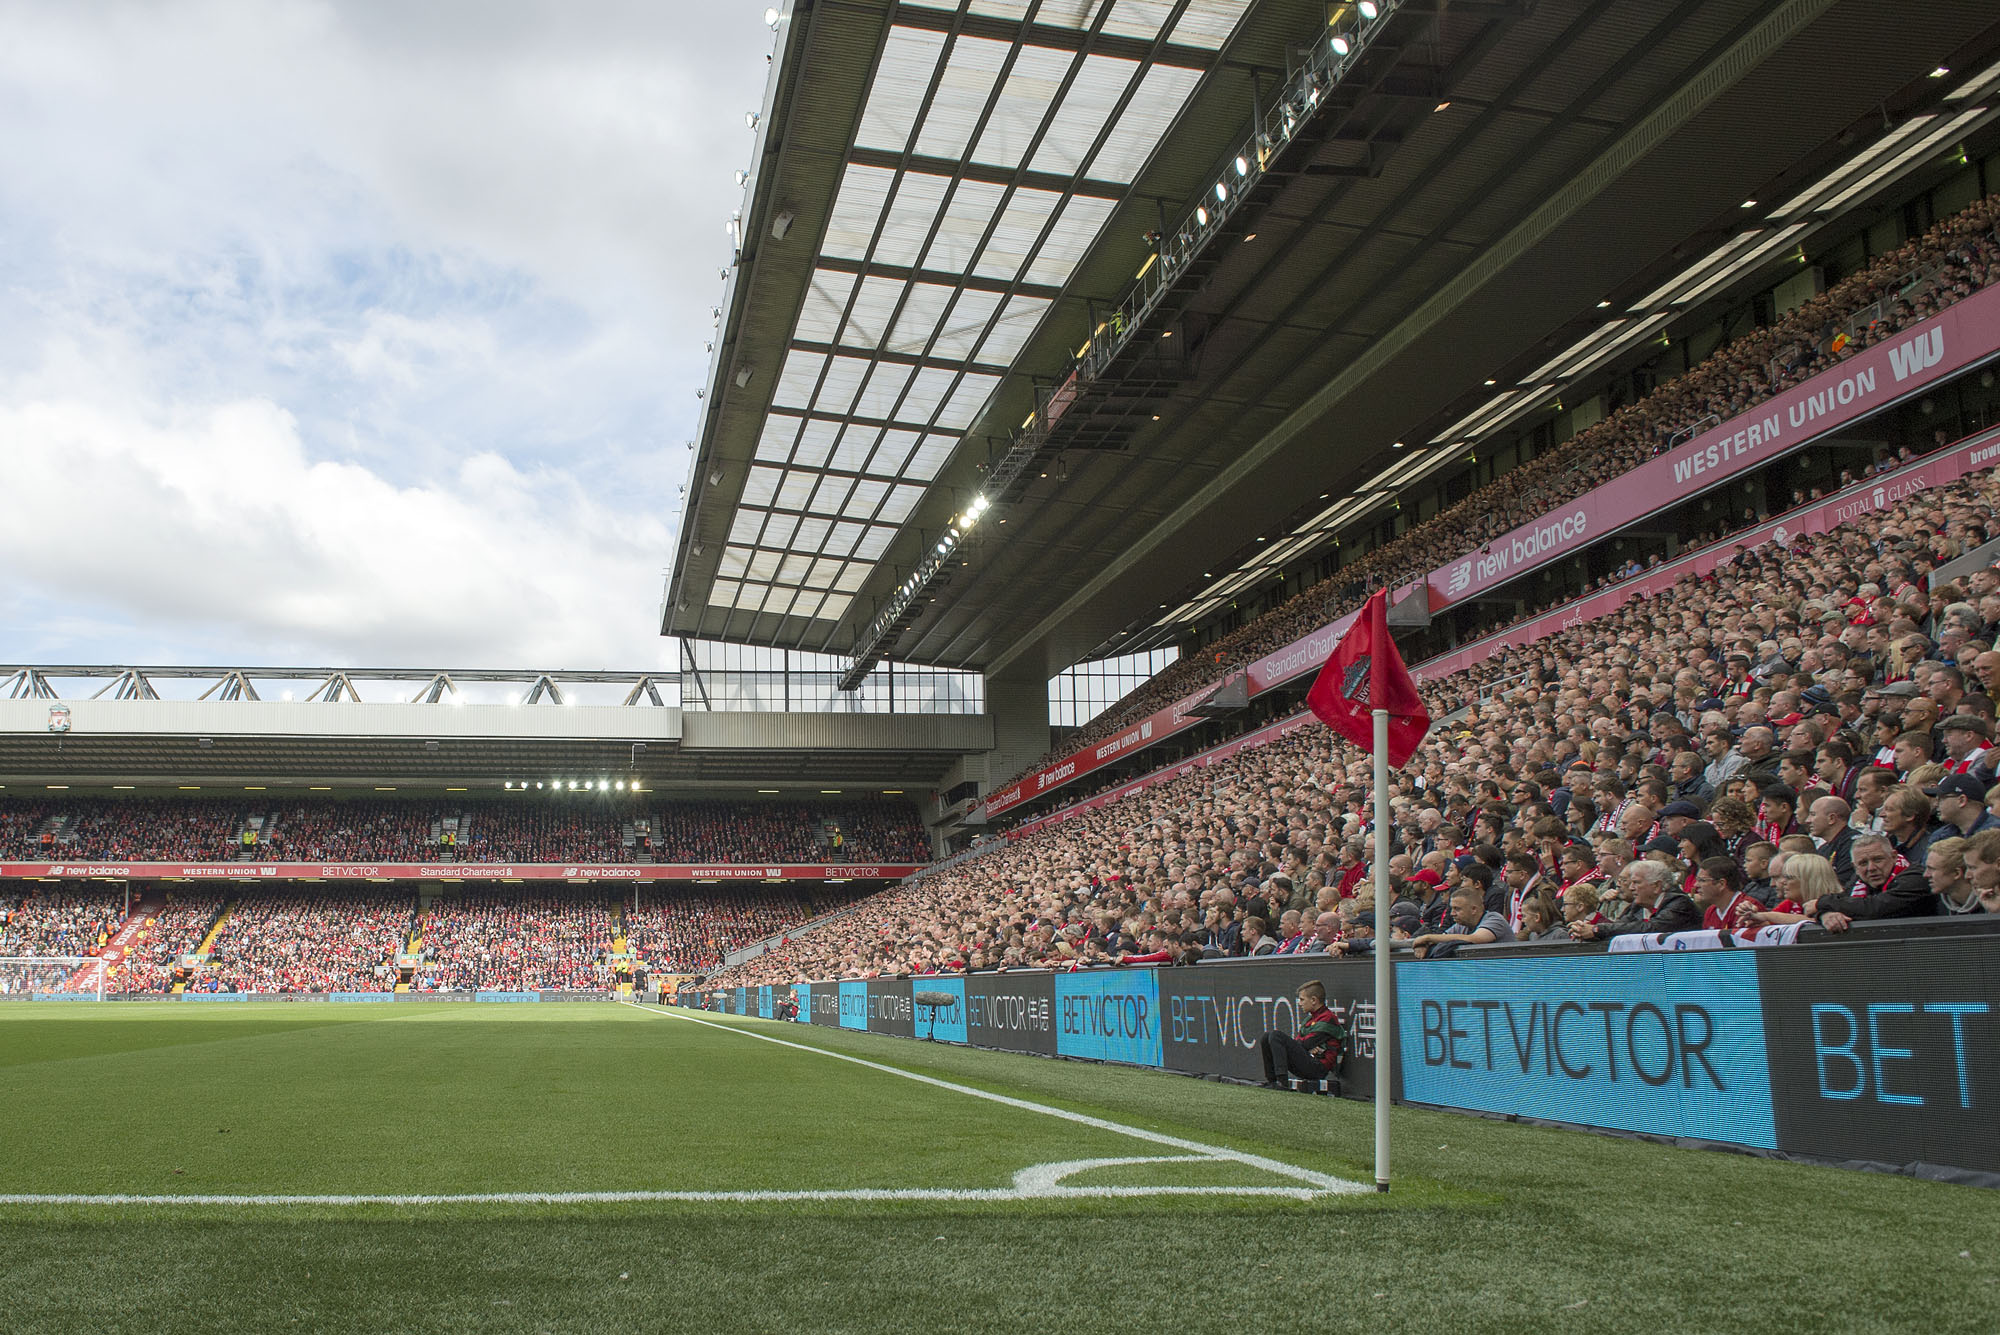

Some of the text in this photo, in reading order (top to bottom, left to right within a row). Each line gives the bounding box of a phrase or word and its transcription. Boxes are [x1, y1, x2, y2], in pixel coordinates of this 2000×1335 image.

[1673, 325, 1945, 484] WESTERN UNION WU
[1835, 476, 1926, 522] TOTAL GLASS
[1477, 547, 1509, 581] new
[1512, 511, 1587, 564] balance
[1266, 648, 1307, 680] Standard
[1096, 739, 1121, 760] WESTERN
[1121, 730, 1140, 749] UNION
[1046, 774, 1055, 785] new
[1055, 762, 1075, 781] balance
[67, 867, 87, 875] new
[89, 866, 130, 875] balance
[322, 866, 379, 876] BETVICTOR
[420, 867, 505, 876] Standard Chartered
[601, 868, 641, 877] balance
[691, 869, 732, 877] WESTERN
[734, 869, 762, 877] UNION
[825, 867, 880, 877] BETVICTOR
[869, 994, 900, 1020] BETVICTOR
[969, 995, 1026, 1030] BETVICTOR
[1063, 995, 1151, 1040] BETVICTOR
[1421, 1000, 1726, 1092] BETVICTOR
[1811, 1001, 1990, 1109] BET
